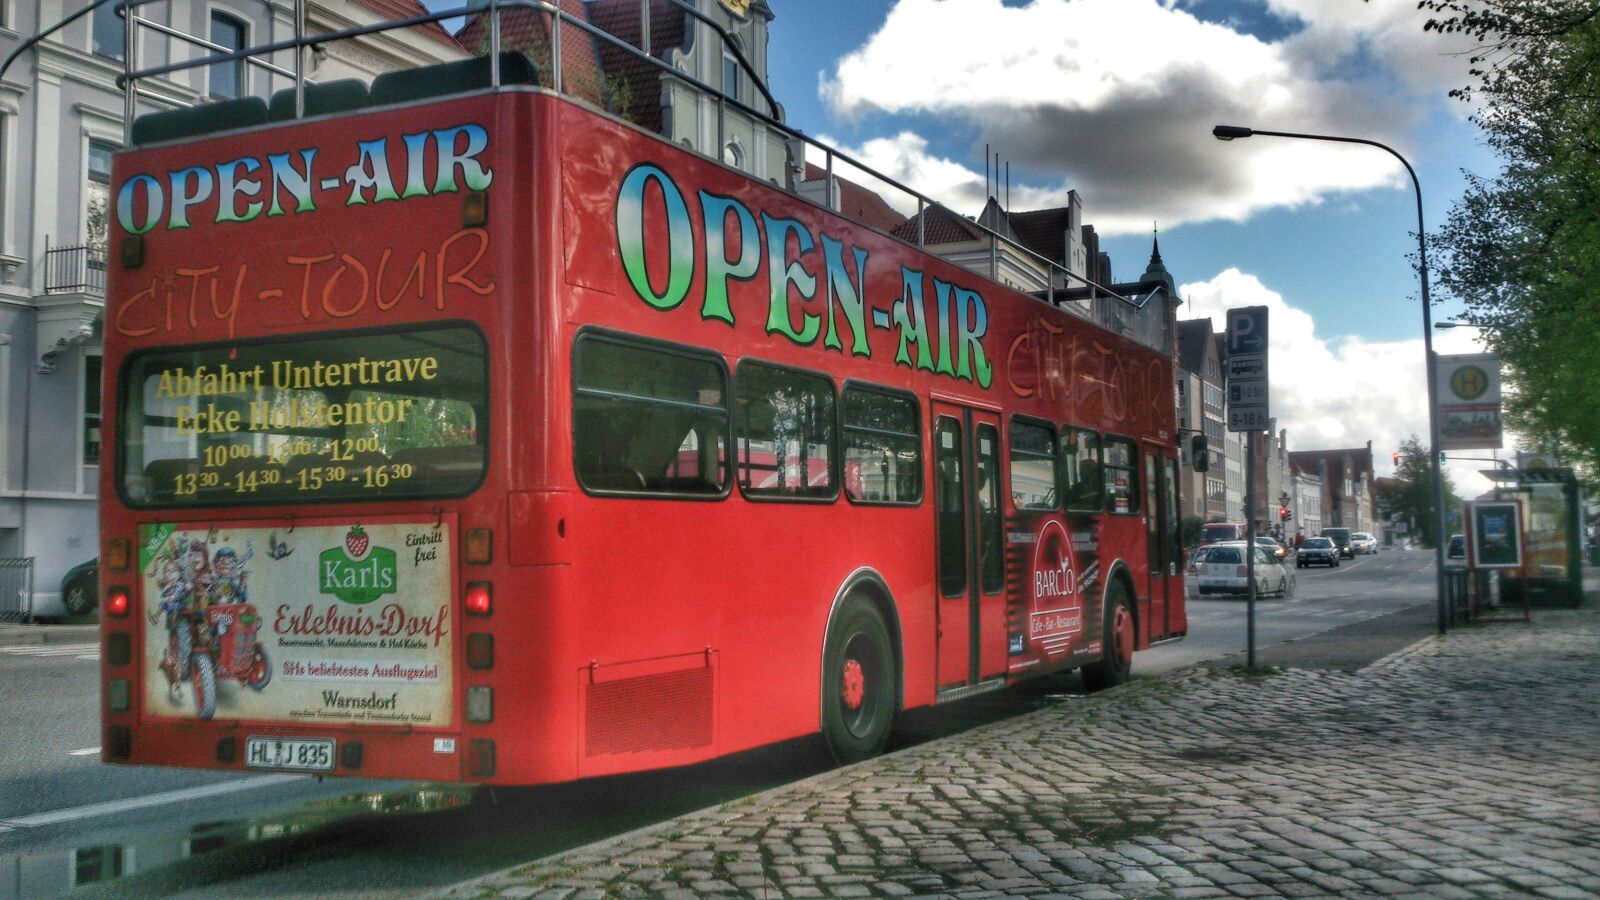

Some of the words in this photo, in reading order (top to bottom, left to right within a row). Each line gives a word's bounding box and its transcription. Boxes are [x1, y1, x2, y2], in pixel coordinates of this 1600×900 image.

[116, 122, 493, 236] OPEN-AIR
[616, 162, 992, 389] OPEN-AIR
[1232, 313, 1255, 349] P
[156, 363, 264, 400] Abfahrt
[271, 355, 438, 391] Untertrave
[176, 403, 241, 437] Ecke
[249, 396, 412, 431] Holstentor
[405, 530, 444, 547] Eintritt
[323, 557, 393, 589] Karls
[414, 547, 438, 567] frei
[273, 603, 450, 647] Erlebnis-Dorf
[307, 661, 369, 678] beliebtestes
[371, 663, 439, 681] Ausflugsziel
[321, 688, 399, 711] Warnsdorf
[251, 740, 272, 763] HL
[299, 743, 328, 765] 835
